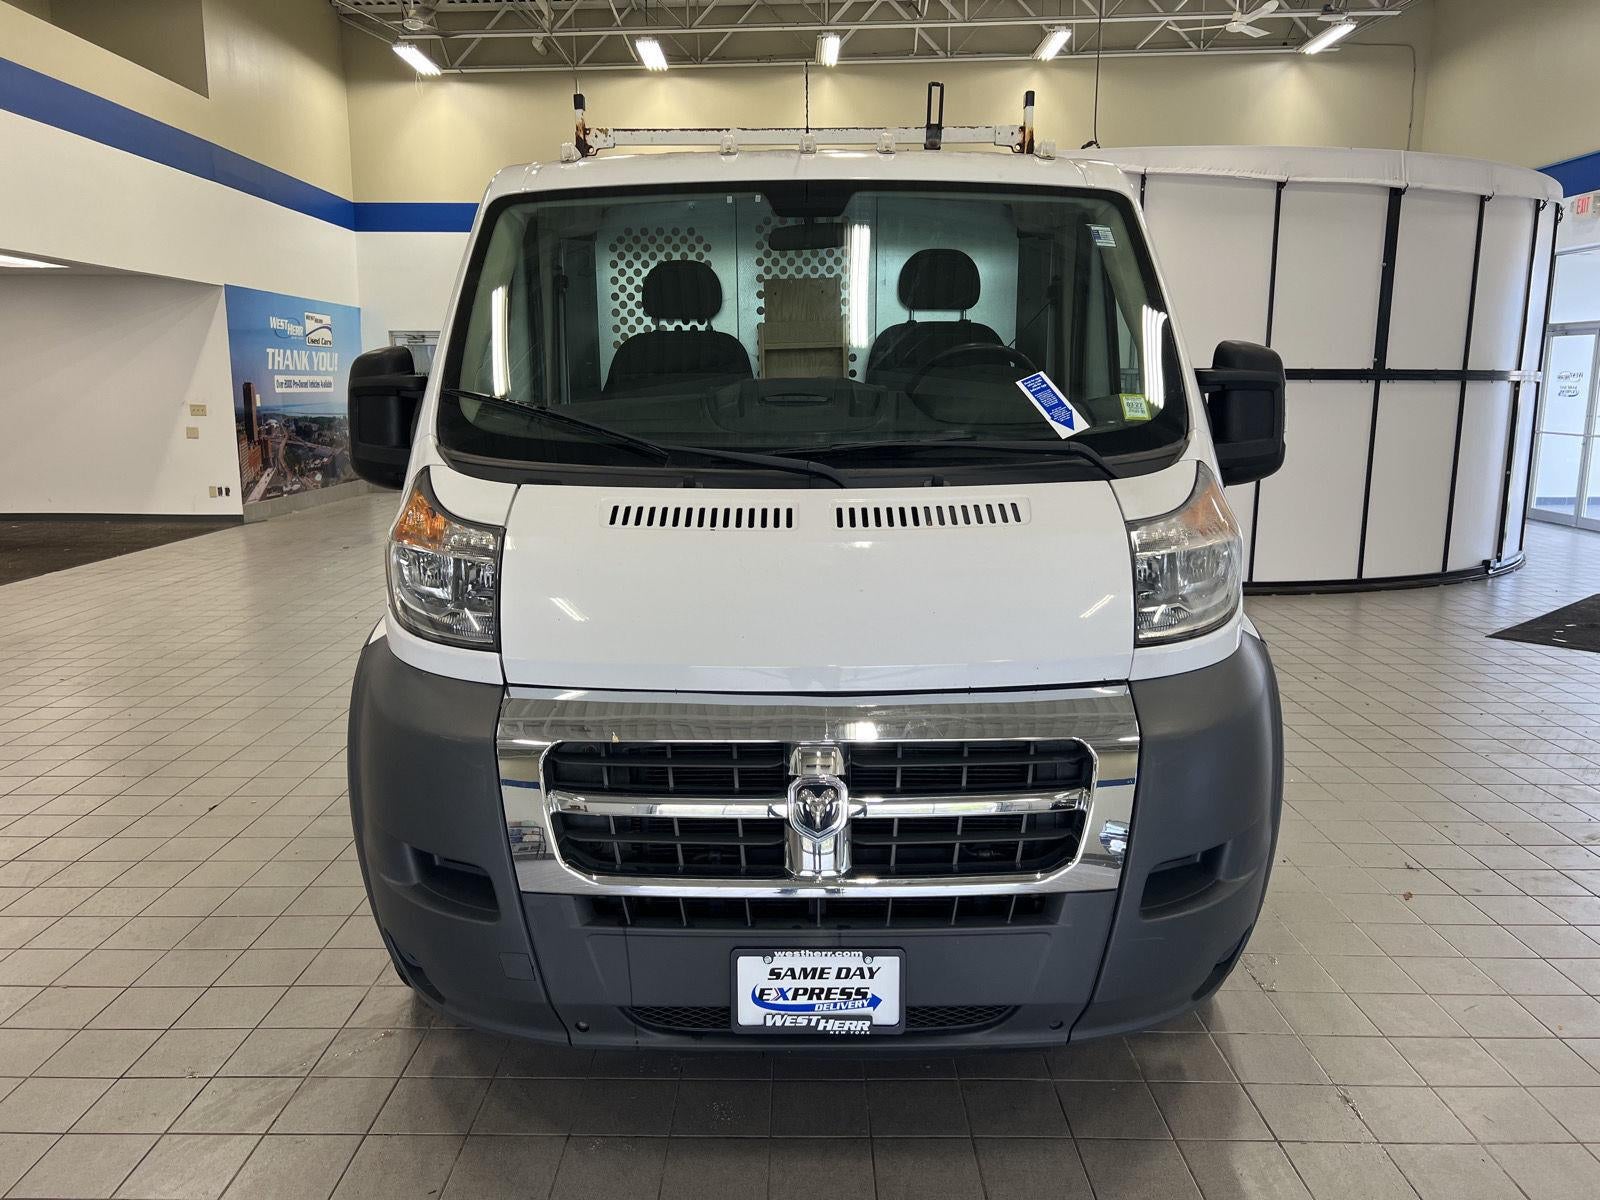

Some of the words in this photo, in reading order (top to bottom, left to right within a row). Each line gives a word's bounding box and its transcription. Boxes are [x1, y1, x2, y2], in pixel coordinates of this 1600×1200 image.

[1576, 196, 1591, 214] EXIT
[308, 337, 320, 345] Used
[321, 338, 332, 346] Cars
[266, 348, 309, 370] THANK
[312, 352, 338, 371] YOU!
[773, 950, 864, 958] westherr.com
[767, 966, 832, 981] SAME
[834, 966, 882, 980] DAY
[757, 987, 870, 1001] EXPRESS
[814, 998, 871, 1012] DELIVERY
